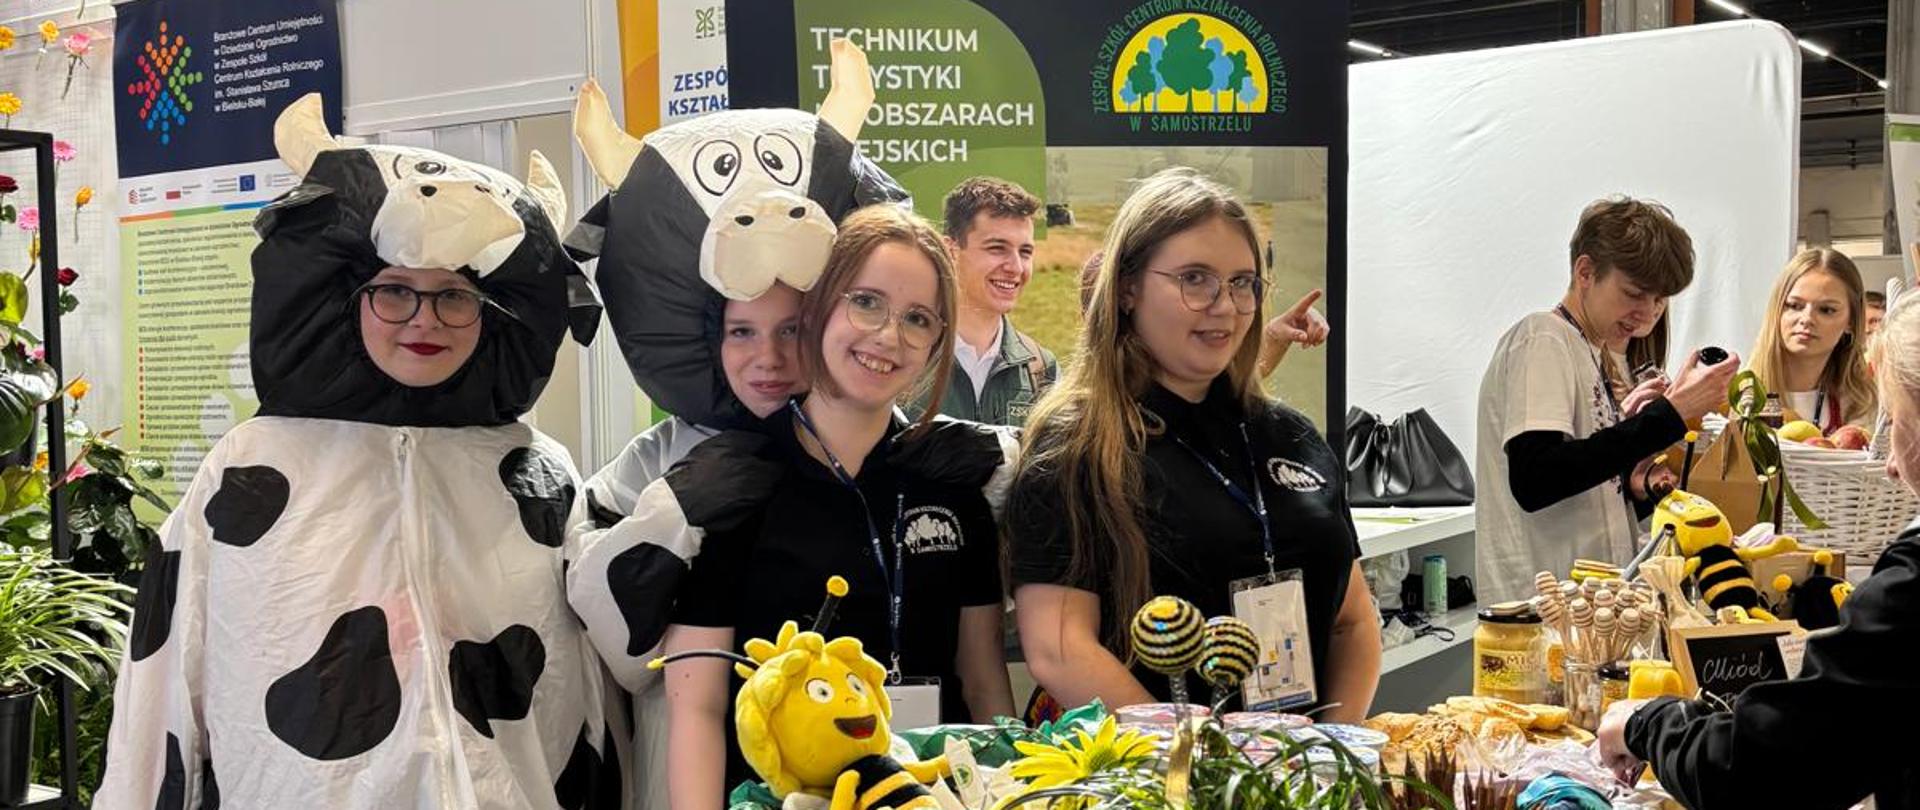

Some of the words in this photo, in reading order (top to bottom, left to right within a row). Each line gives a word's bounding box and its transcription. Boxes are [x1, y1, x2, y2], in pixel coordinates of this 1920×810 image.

[1124, 0, 1182, 28] CENTRUM
[1187, 0, 1263, 38] KSZTAŁCENIA
[213, 29, 246, 42] Branżowe
[248, 23, 276, 36] Centrum
[1098, 24, 1130, 63] SZKÓŁ
[213, 72, 244, 84] Centrum
[282, 58, 325, 73] Rolniczego
[674, 65, 728, 92] ZESPÓ
[812, 65, 961, 90] TYSTYKI
[1259, 33, 1288, 113] ROLNICZEGO
[1089, 66, 1111, 113] ZESPÓŁ
[668, 93, 729, 117] KSZTAŁ
[865, 102, 1034, 126] OBSZARACH
[1130, 115, 1143, 132] W
[1151, 115, 1252, 132] SAMOSTRZELU
[857, 138, 968, 162] EJSKICH
